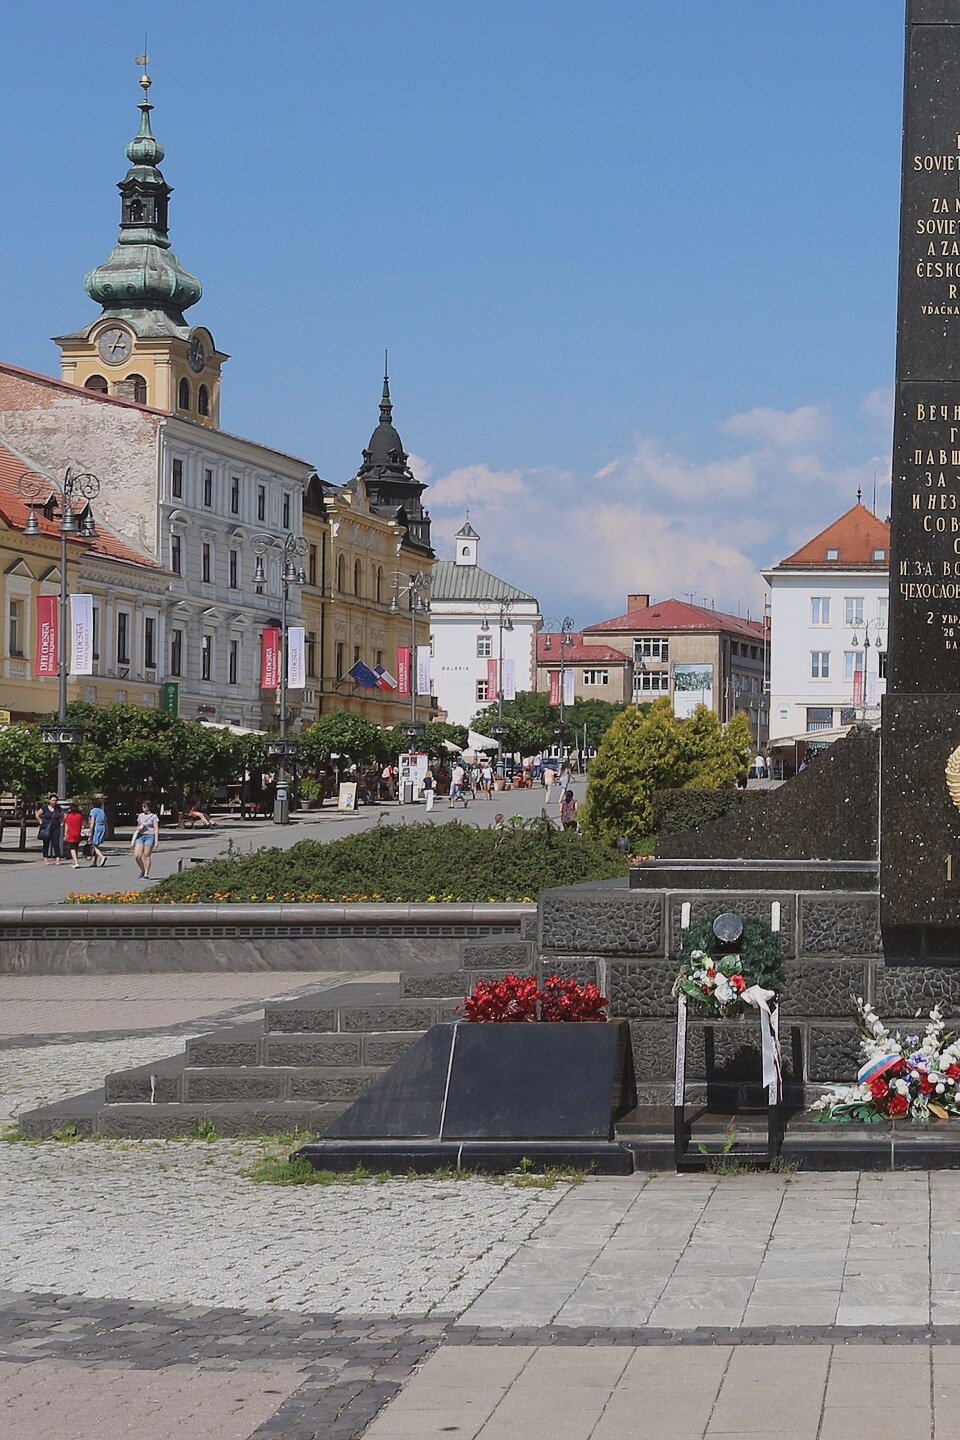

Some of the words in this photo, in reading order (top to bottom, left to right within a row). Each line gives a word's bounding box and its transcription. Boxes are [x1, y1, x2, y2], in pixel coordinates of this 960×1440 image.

[931, 198, 949, 214] ZA
[927, 241, 936, 256] A
[941, 241, 959, 256] ZA
[925, 471, 946, 487] ЗА
[912, 494, 920, 509] И
[900, 561, 907, 576] И
[915, 561, 933, 576] ЗА
[927, 611, 934, 624] 2
[42, 623, 50, 654] MESTA
[943, 628, 954, 637] 26
